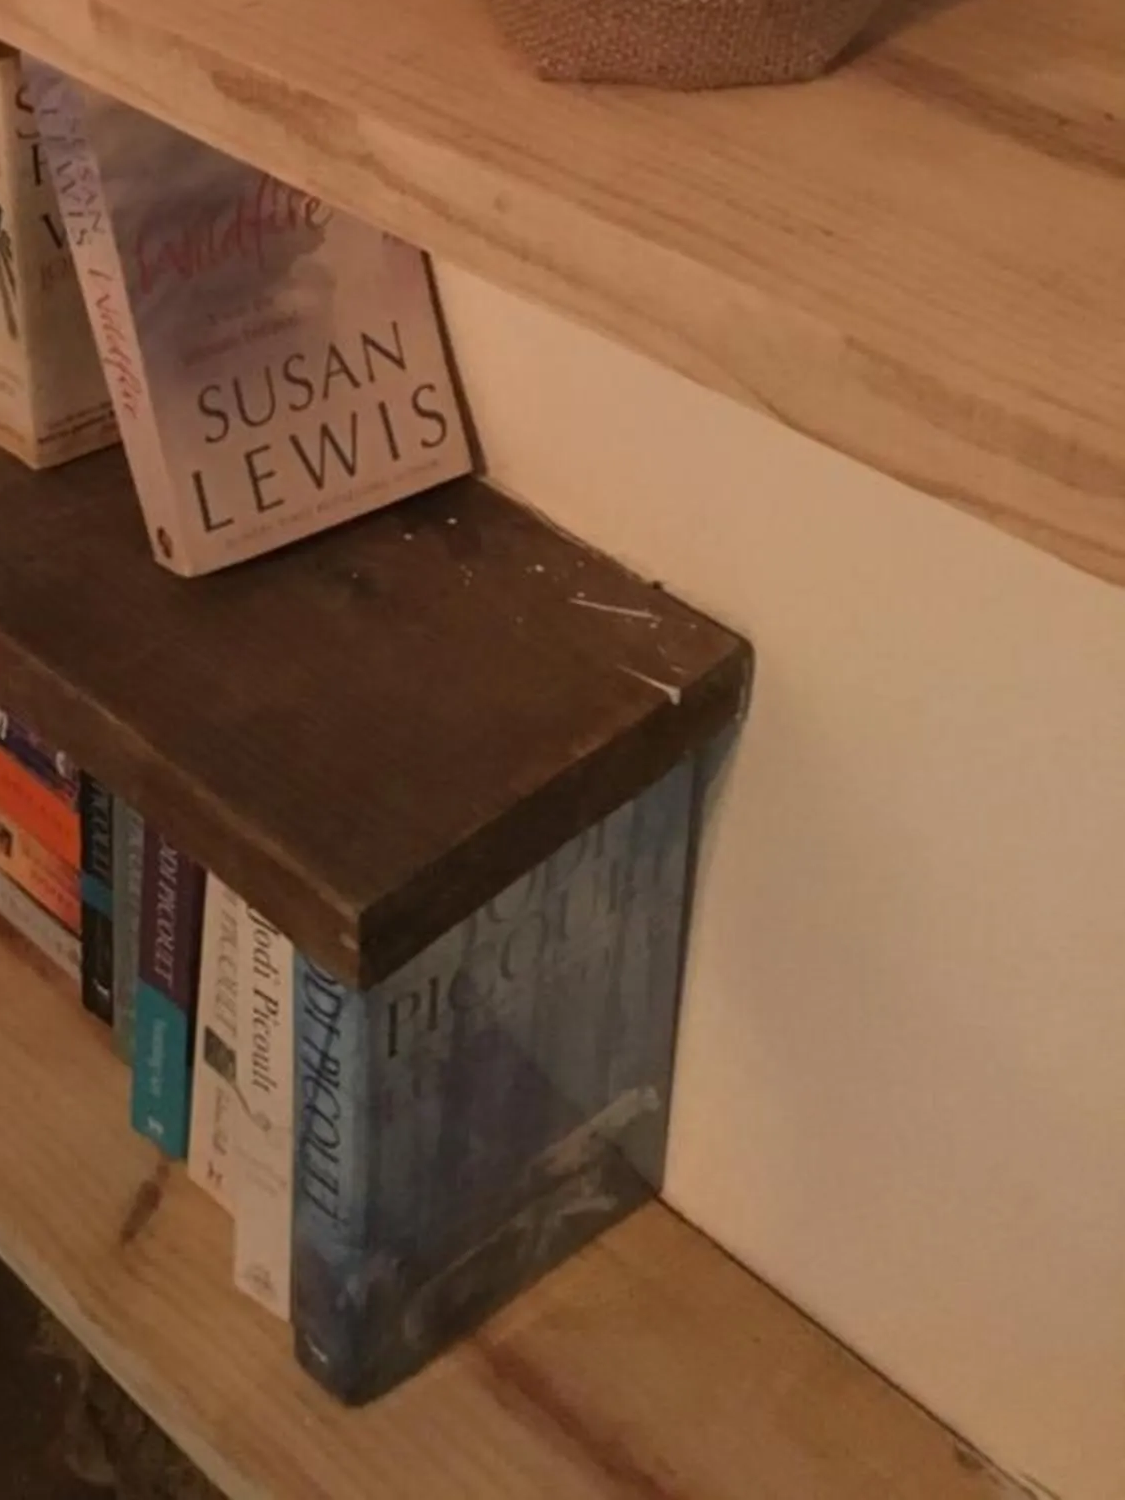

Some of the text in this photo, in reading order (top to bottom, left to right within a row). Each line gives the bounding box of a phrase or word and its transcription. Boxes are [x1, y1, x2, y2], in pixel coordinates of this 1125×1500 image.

[197, 320, 407, 444] SUSAN
[191, 381, 449, 533] LEWIS
[154, 879, 178, 992] PICOULT
[249, 905, 282, 1095] Jodi Picoult
